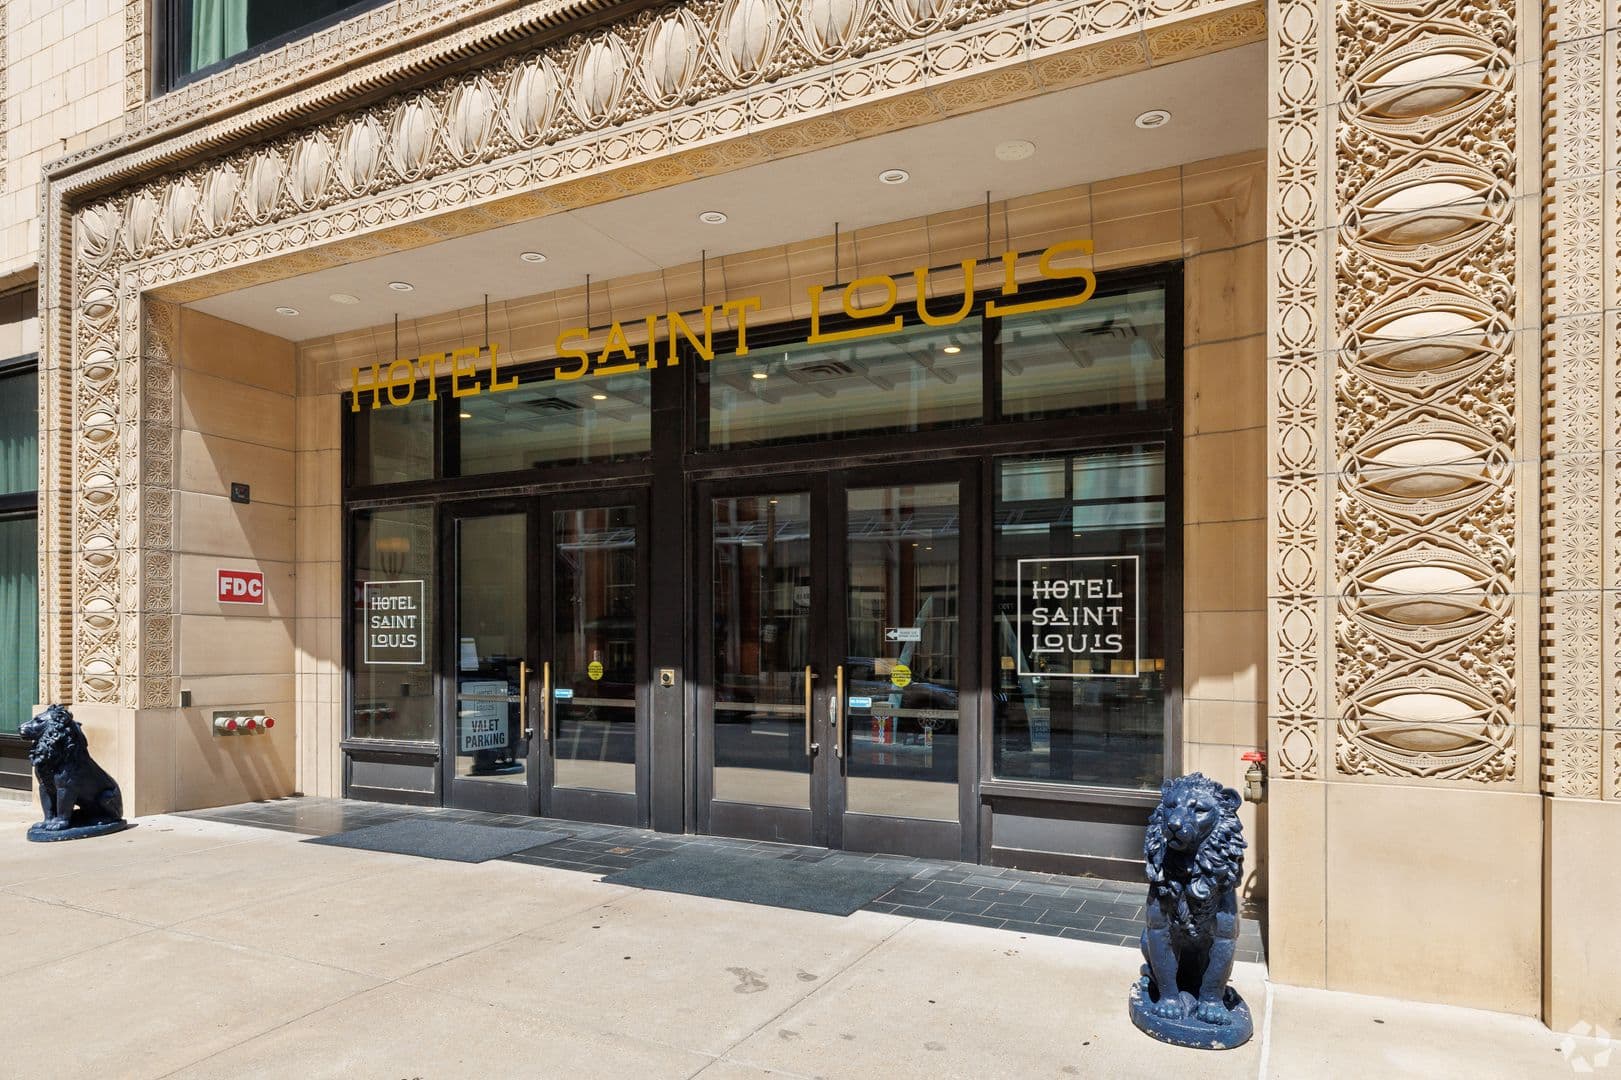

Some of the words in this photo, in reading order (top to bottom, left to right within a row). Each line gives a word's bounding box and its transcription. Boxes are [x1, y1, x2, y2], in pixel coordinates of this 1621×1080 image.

[350, 342, 519, 413] HOTEL
[554, 295, 762, 382] SAINT
[806, 239, 1097, 345] LOUIS
[220, 577, 262, 597] FDC
[1032, 579, 1123, 600] HOTEL
[371, 596, 416, 610] HOTEL
[371, 615, 417, 629] SAINT
[1032, 606, 1123, 626] SAINT
[371, 634, 417, 648] LOUIS
[1032, 633, 1123, 654] LOUIS
[471, 718, 500, 733] VALET
[465, 733, 505, 748] PARKING
